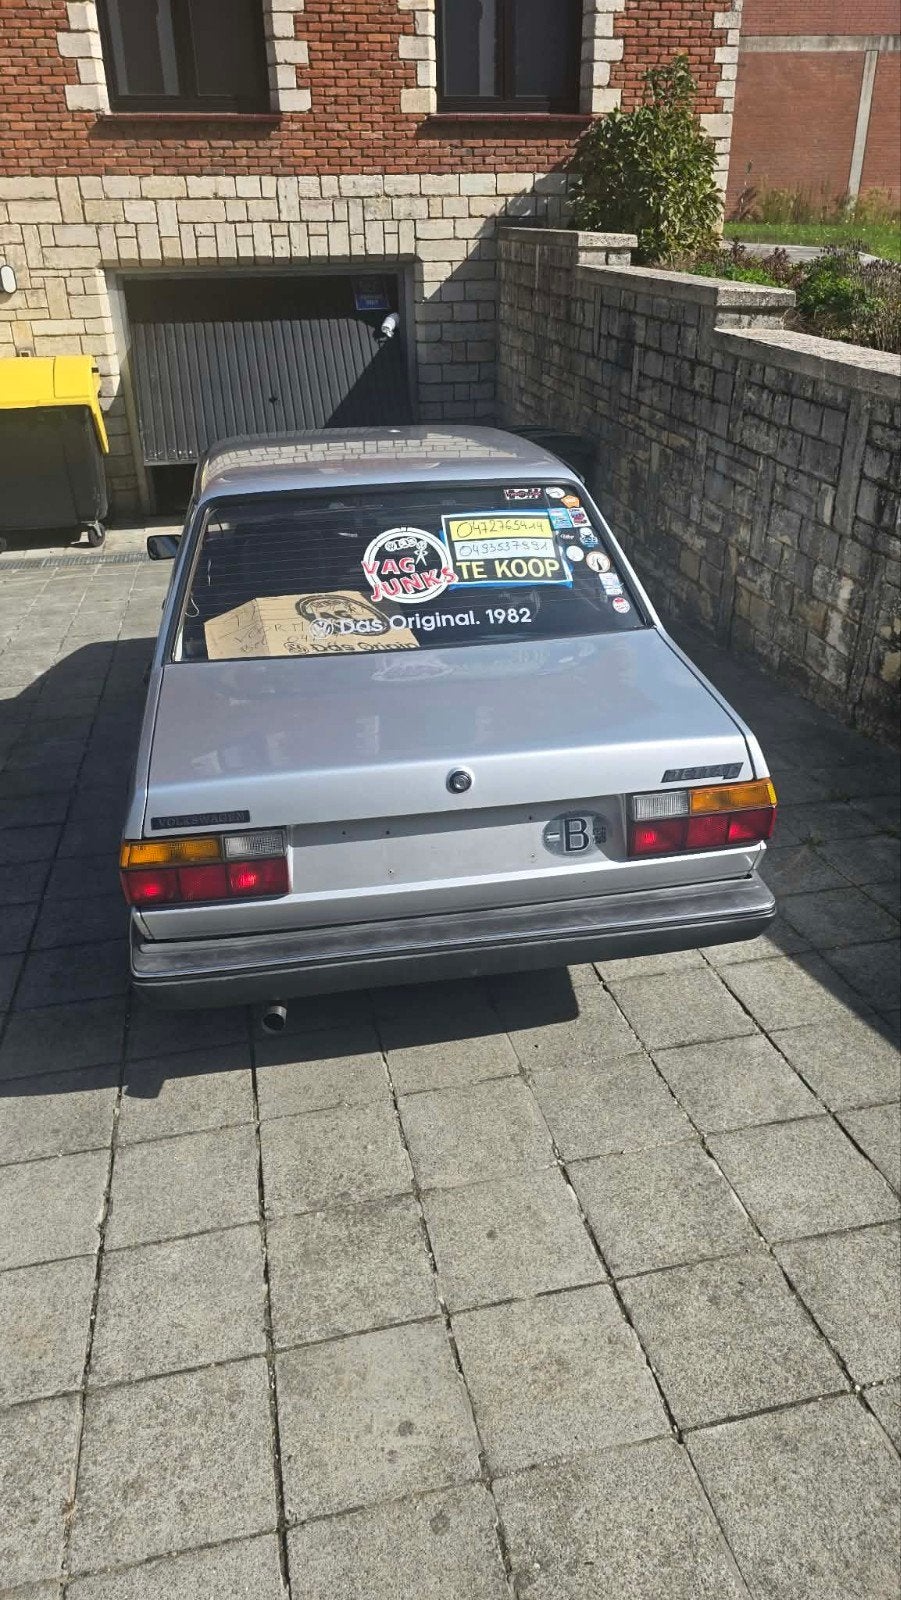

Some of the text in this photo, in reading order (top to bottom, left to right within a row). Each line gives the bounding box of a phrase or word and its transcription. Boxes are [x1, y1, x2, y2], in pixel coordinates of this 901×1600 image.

[361, 556, 416, 575] VAG
[455, 557, 560, 579] TE KOOP
[370, 565, 459, 602] JUNKS
[339, 617, 384, 635] Das
[389, 610, 481, 631] Original.
[485, 607, 533, 625] 1982
[157, 811, 247, 827] VOLKSWAGEN
[563, 817, 591, 853] B
